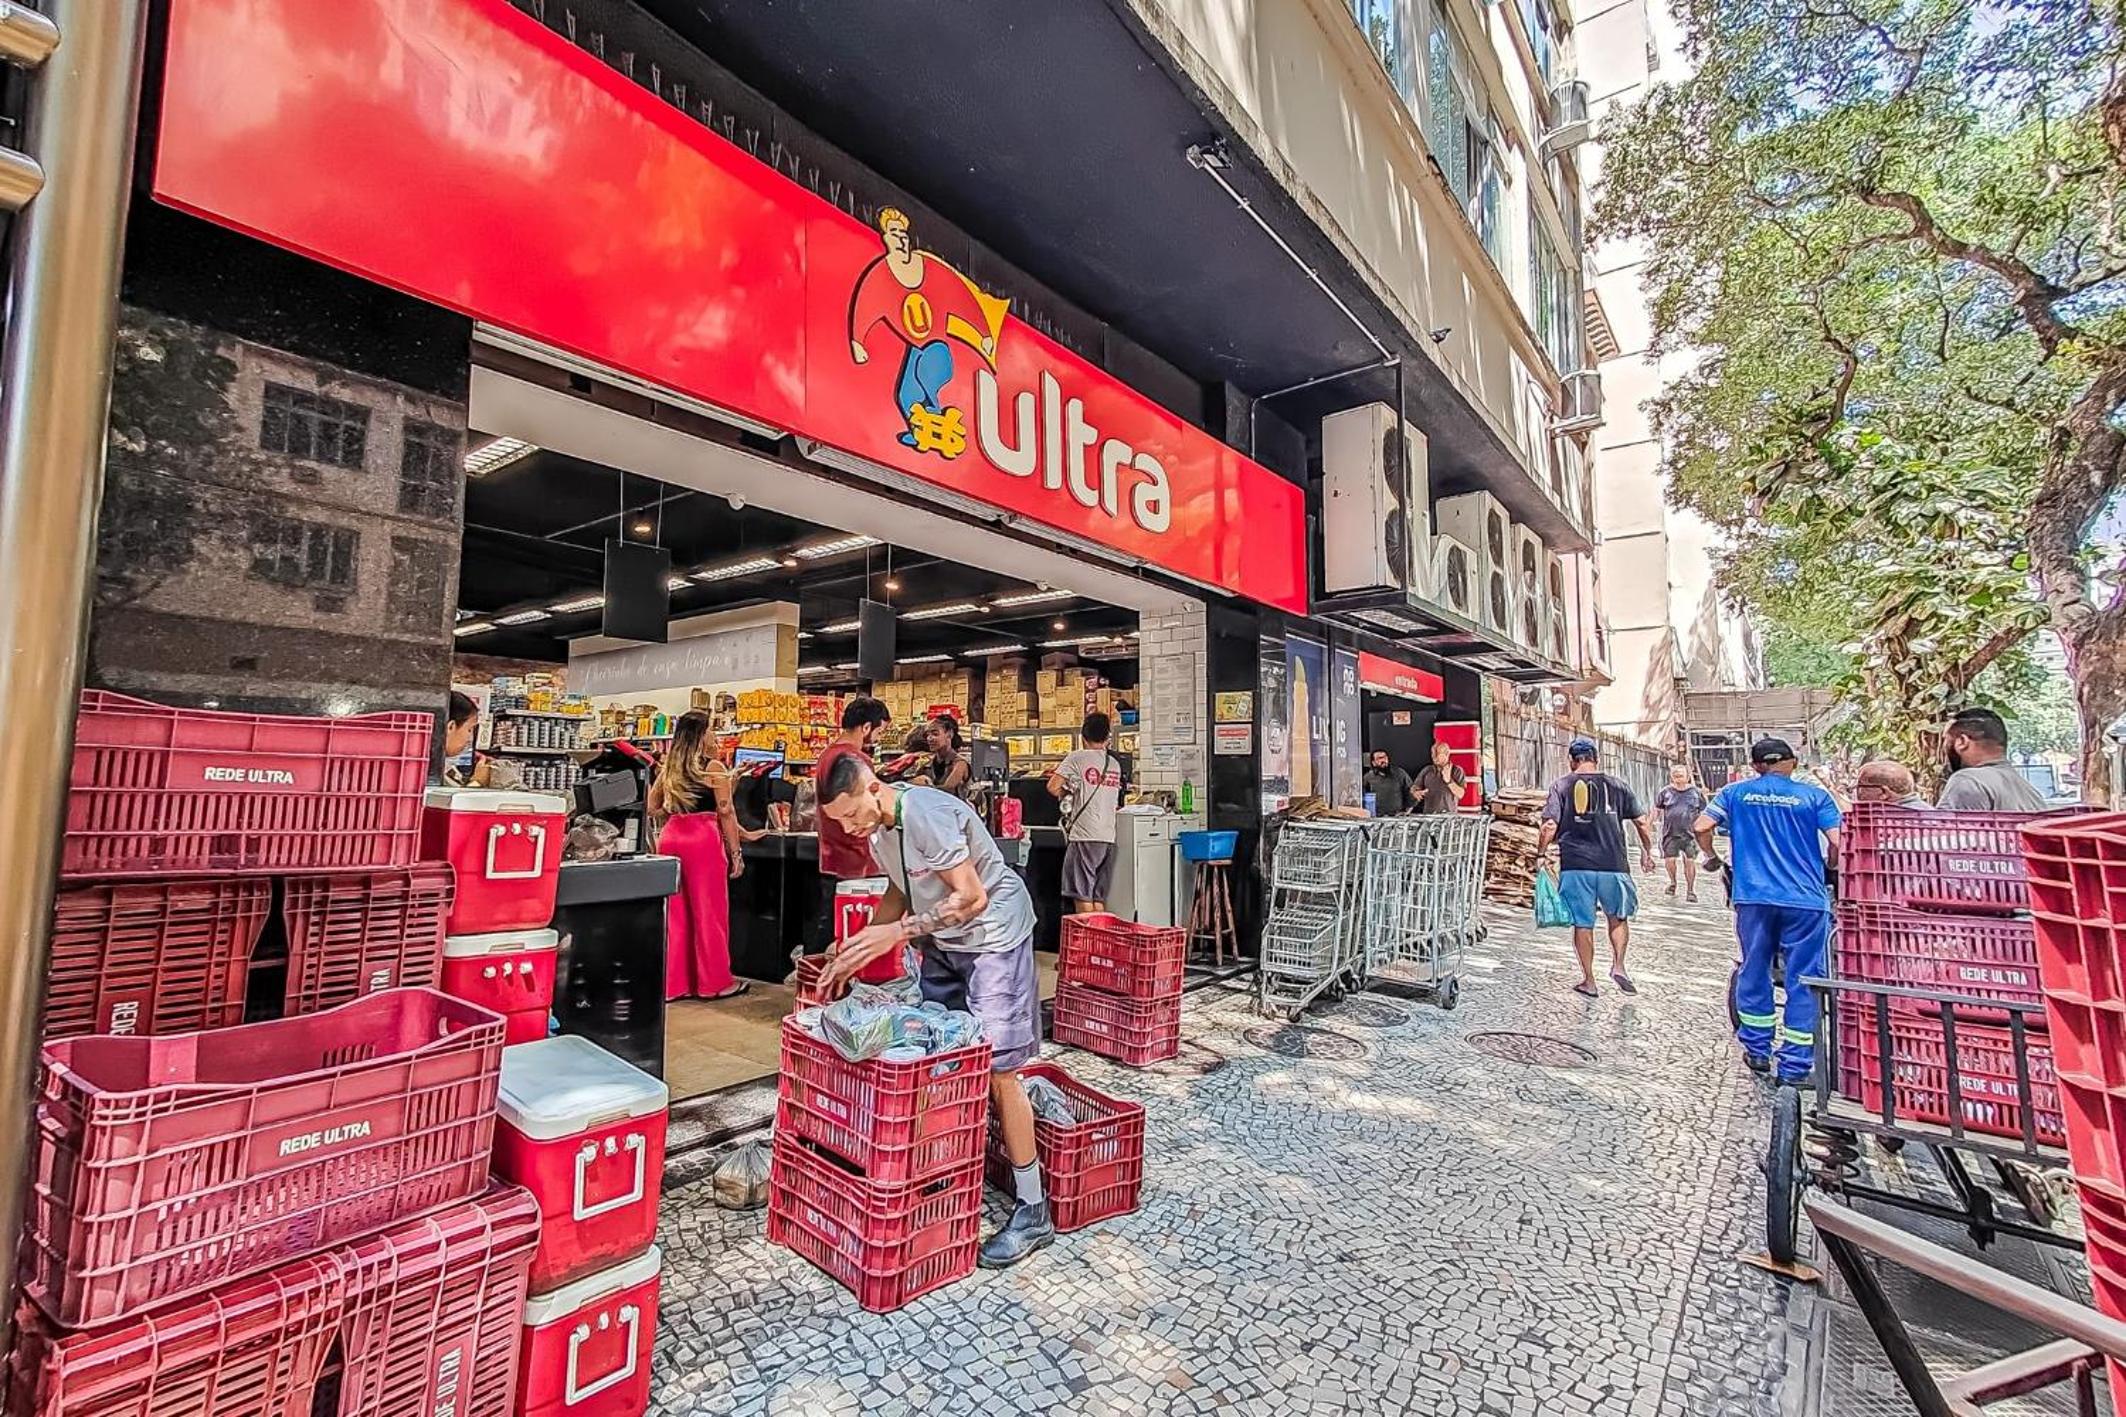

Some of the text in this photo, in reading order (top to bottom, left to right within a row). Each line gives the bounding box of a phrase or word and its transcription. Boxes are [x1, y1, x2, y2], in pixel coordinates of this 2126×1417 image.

[975, 368, 1171, 534] ultra
[204, 766, 294, 784] REDE ULTRA
[1948, 858, 2016, 875] REDE ULTRA
[370, 968, 391, 992] TRA
[1959, 966, 2028, 985] REDE ULTRA
[1959, 1075, 1989, 1092] REDE
[279, 1120, 371, 1157] REDE ULTRA
[436, 1347, 462, 1400] ULTRA
